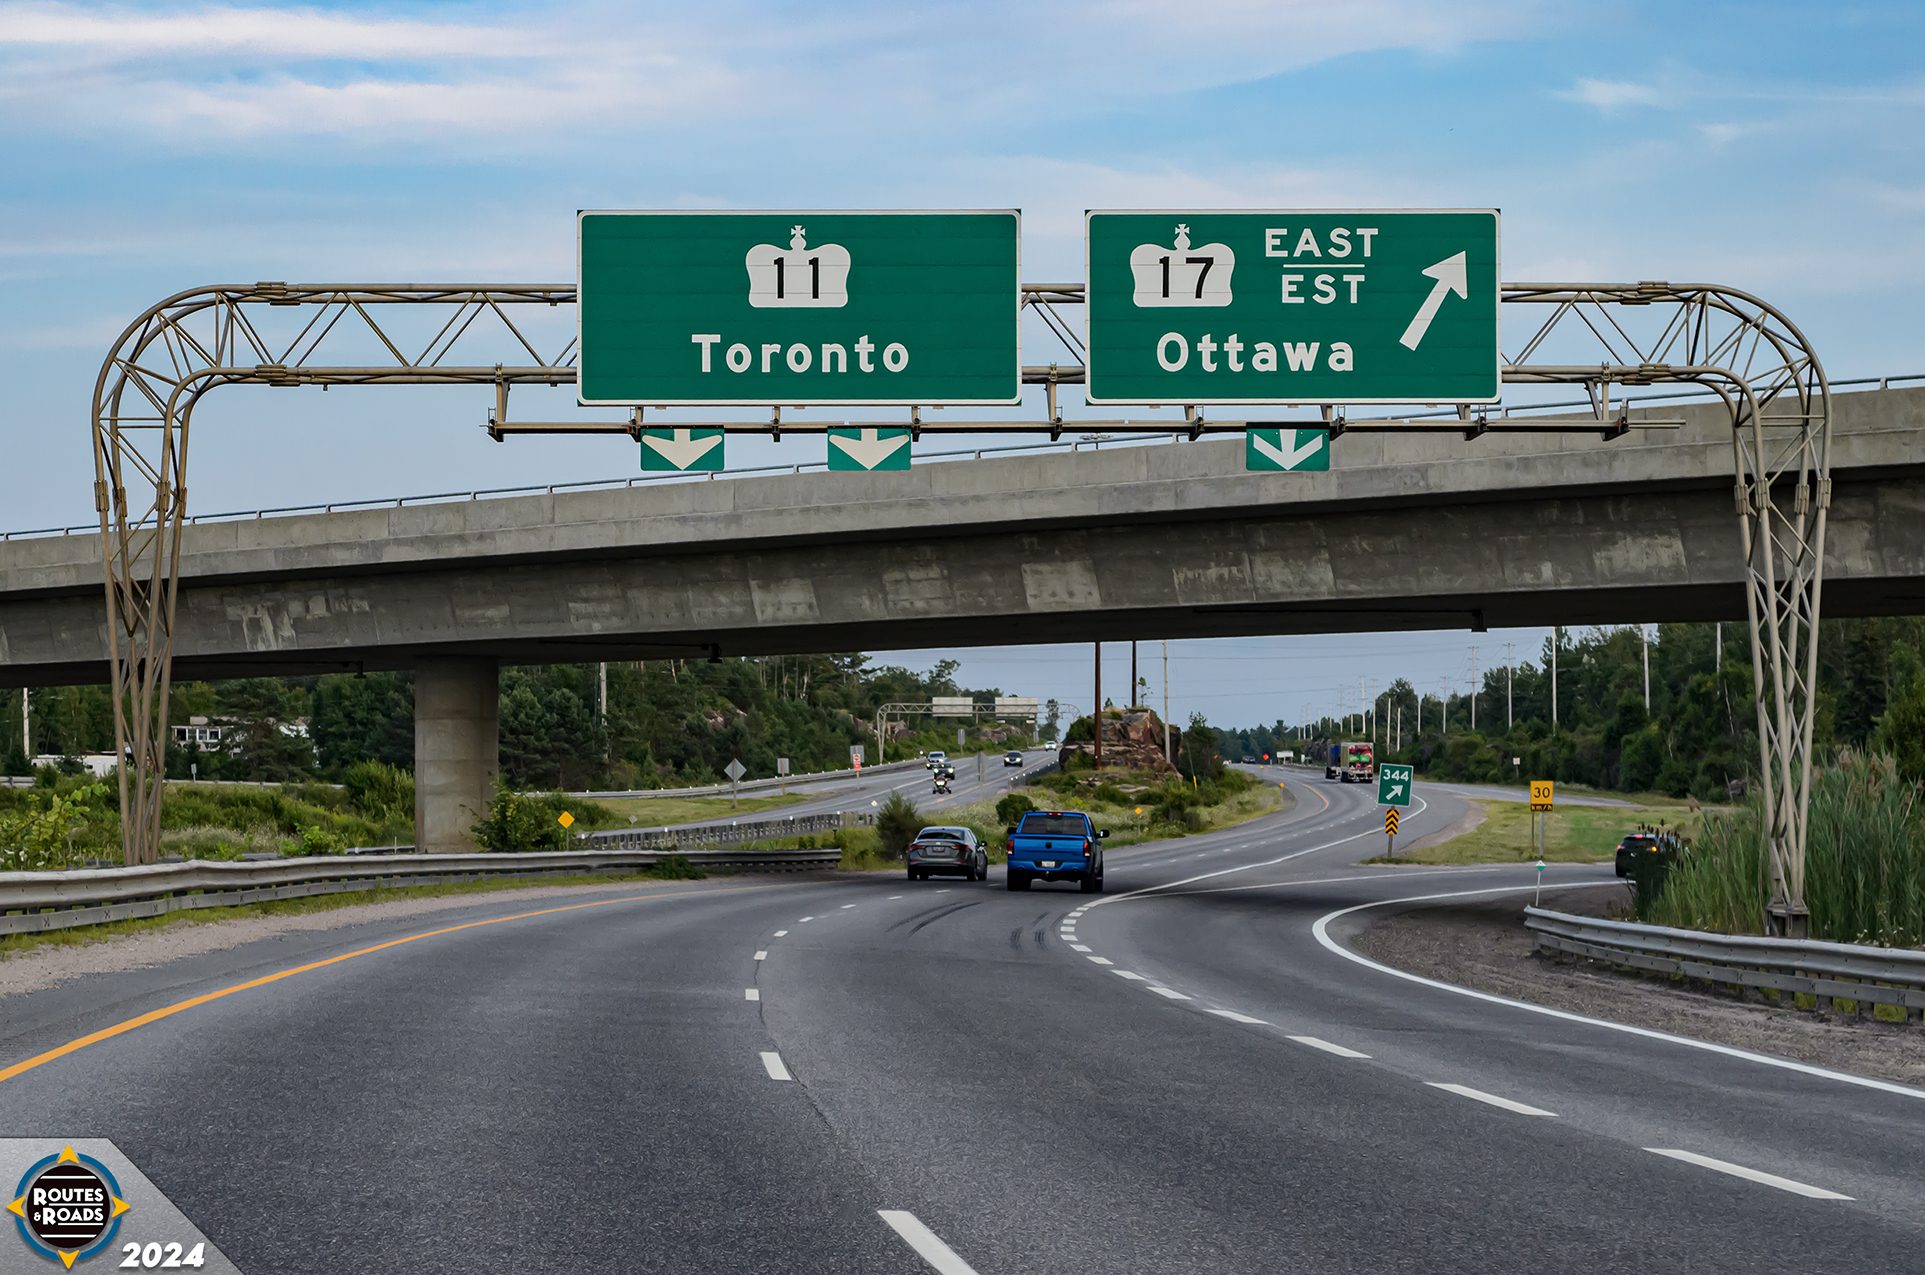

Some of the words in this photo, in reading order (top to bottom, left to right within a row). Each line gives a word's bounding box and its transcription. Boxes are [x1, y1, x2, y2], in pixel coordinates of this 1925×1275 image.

[1265, 228, 1379, 258] EAST
[773, 256, 820, 300] 11
[1158, 256, 1215, 299] 17
[1281, 274, 1365, 305] EST
[691, 333, 909, 373] Toronto
[1156, 332, 1354, 373] Ottawa
[1383, 769, 1409, 781] 344
[1534, 787, 1550, 798] 30
